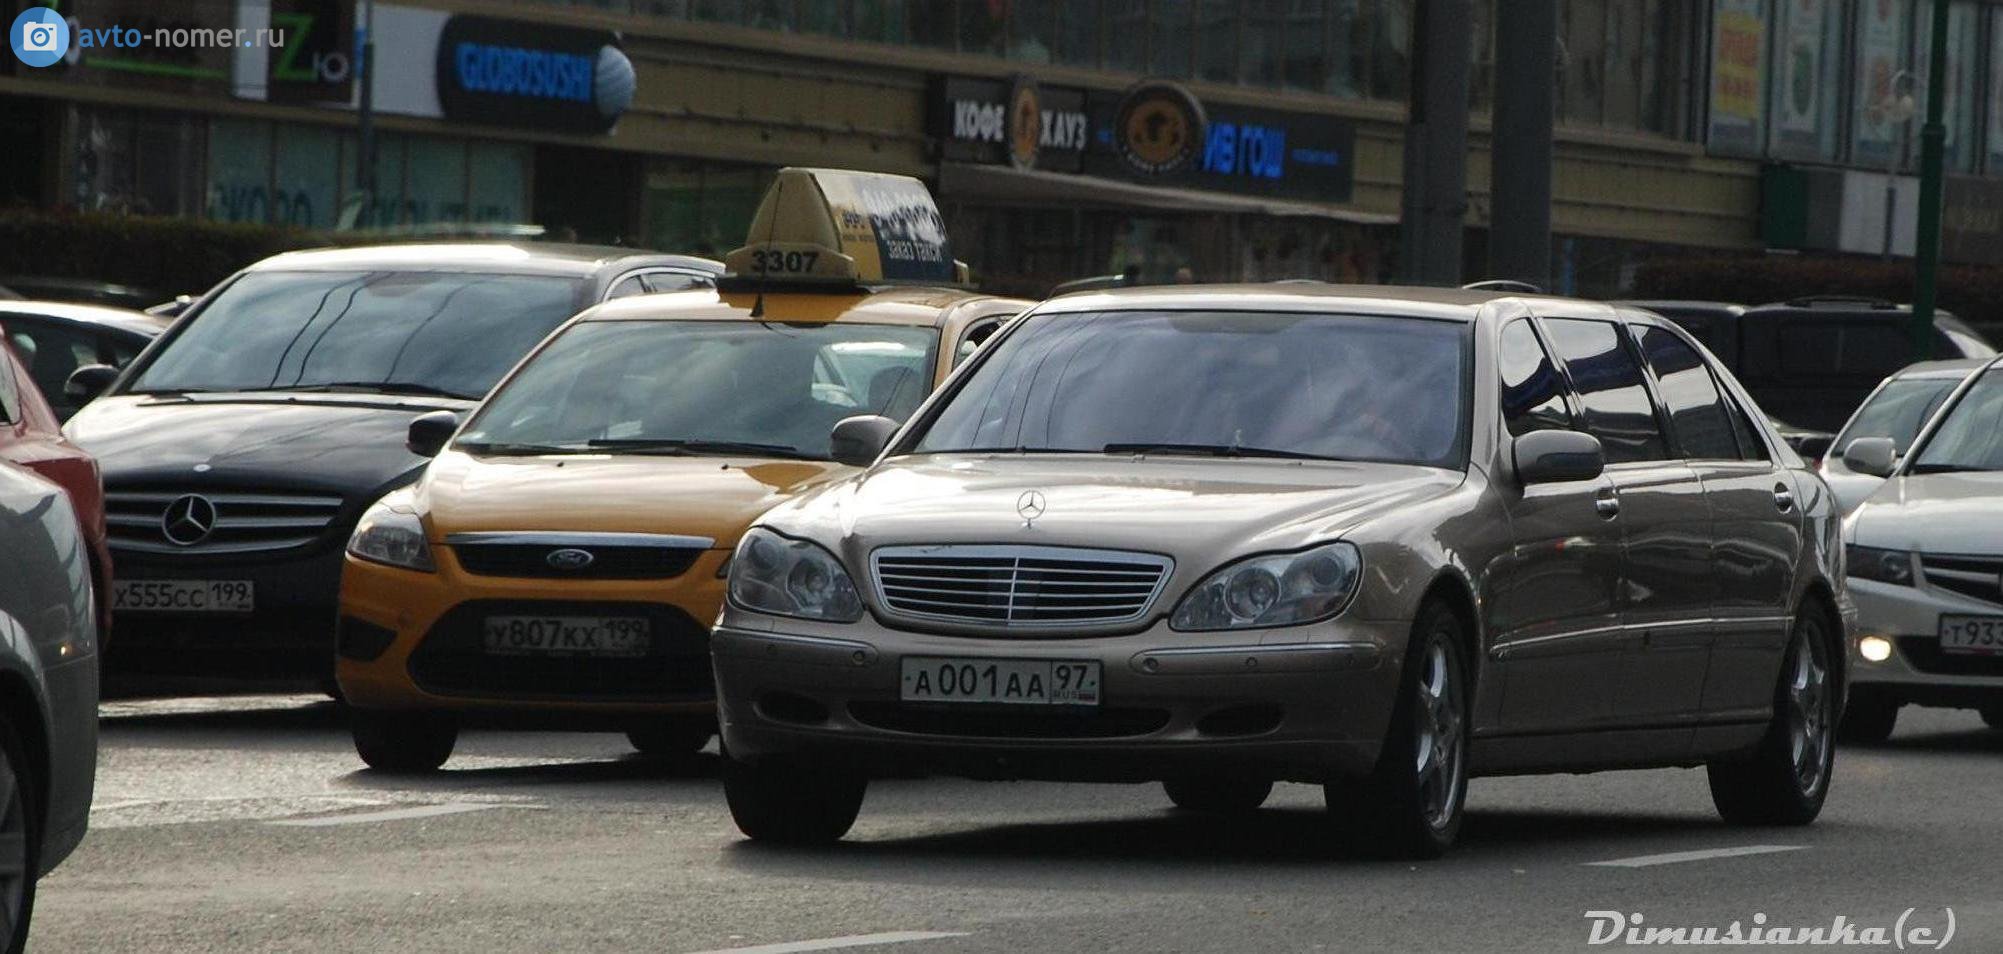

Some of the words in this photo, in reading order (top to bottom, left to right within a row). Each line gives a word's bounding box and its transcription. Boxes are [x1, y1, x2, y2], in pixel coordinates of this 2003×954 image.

[456, 41, 591, 102] GLOBOSUSHI
[954, 101, 1004, 141] КОФЕ
[1040, 110, 1087, 149] ХАУЗ
[752, 251, 820, 274] 3307
[212, 583, 248, 601] 199
[1056, 665, 1088, 690] 97
